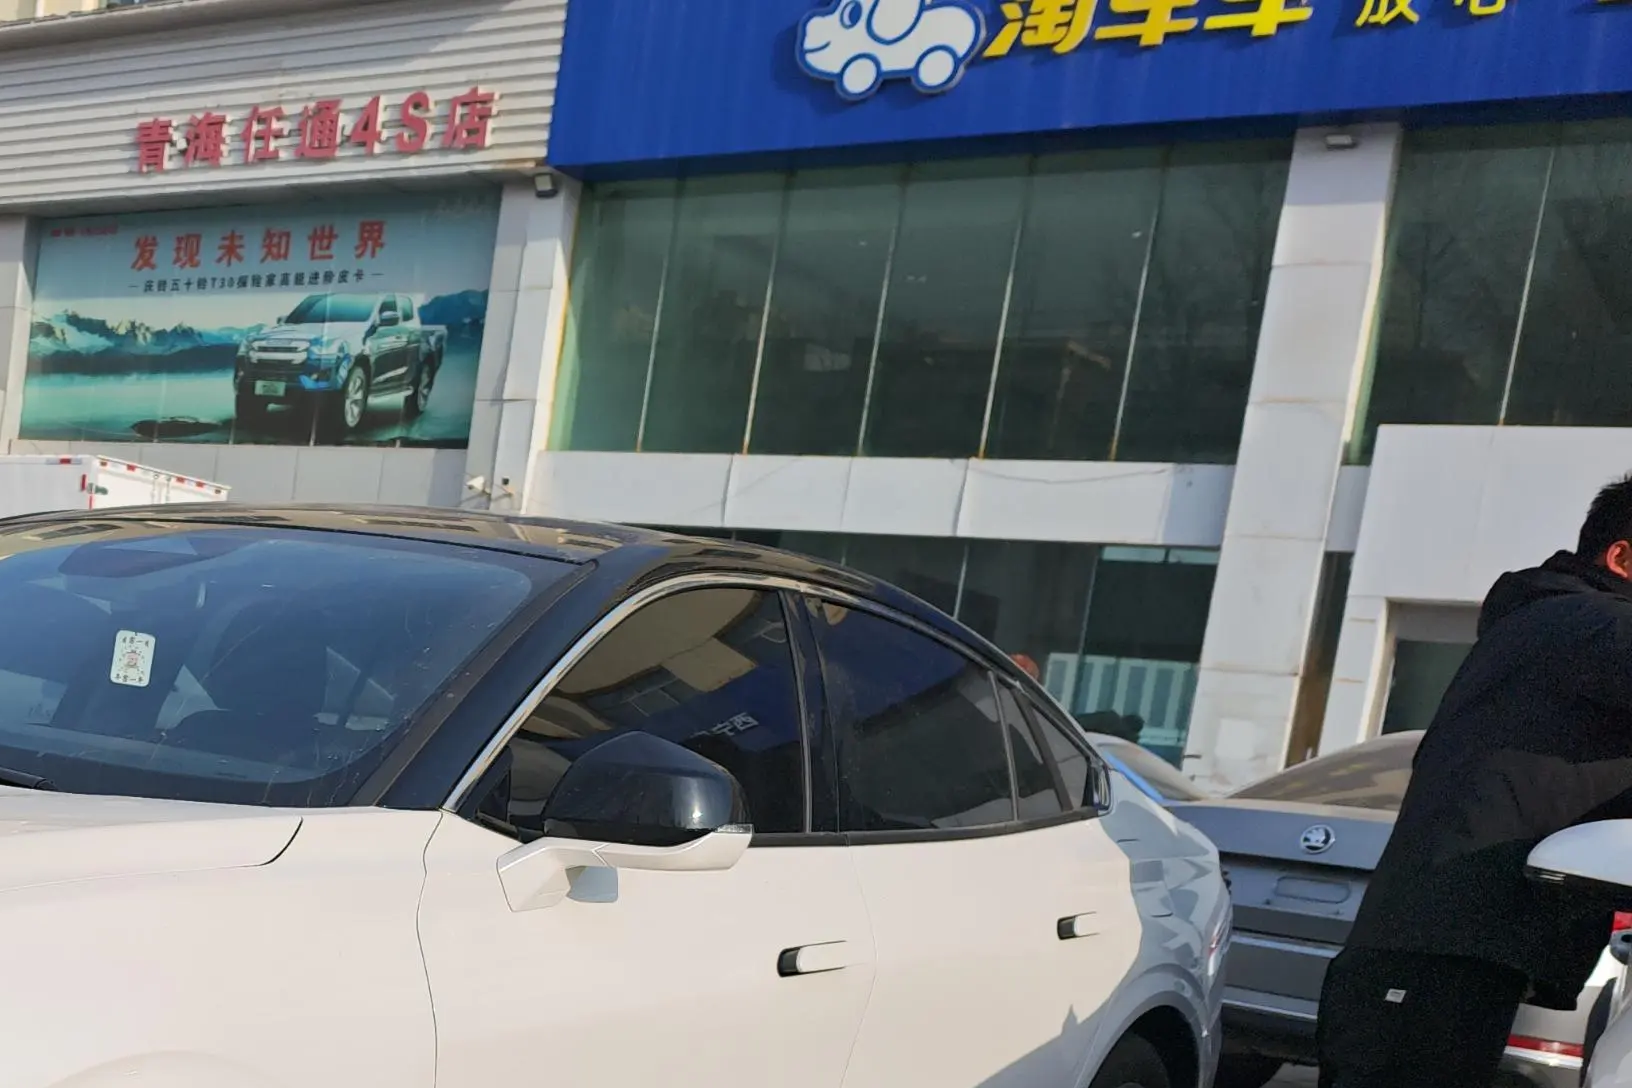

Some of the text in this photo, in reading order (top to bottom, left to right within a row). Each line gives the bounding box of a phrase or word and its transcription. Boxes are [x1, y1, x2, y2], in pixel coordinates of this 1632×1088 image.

[135, 86, 498, 174] 青海任通4S店
[130, 219, 388, 272] 发现未知世界
